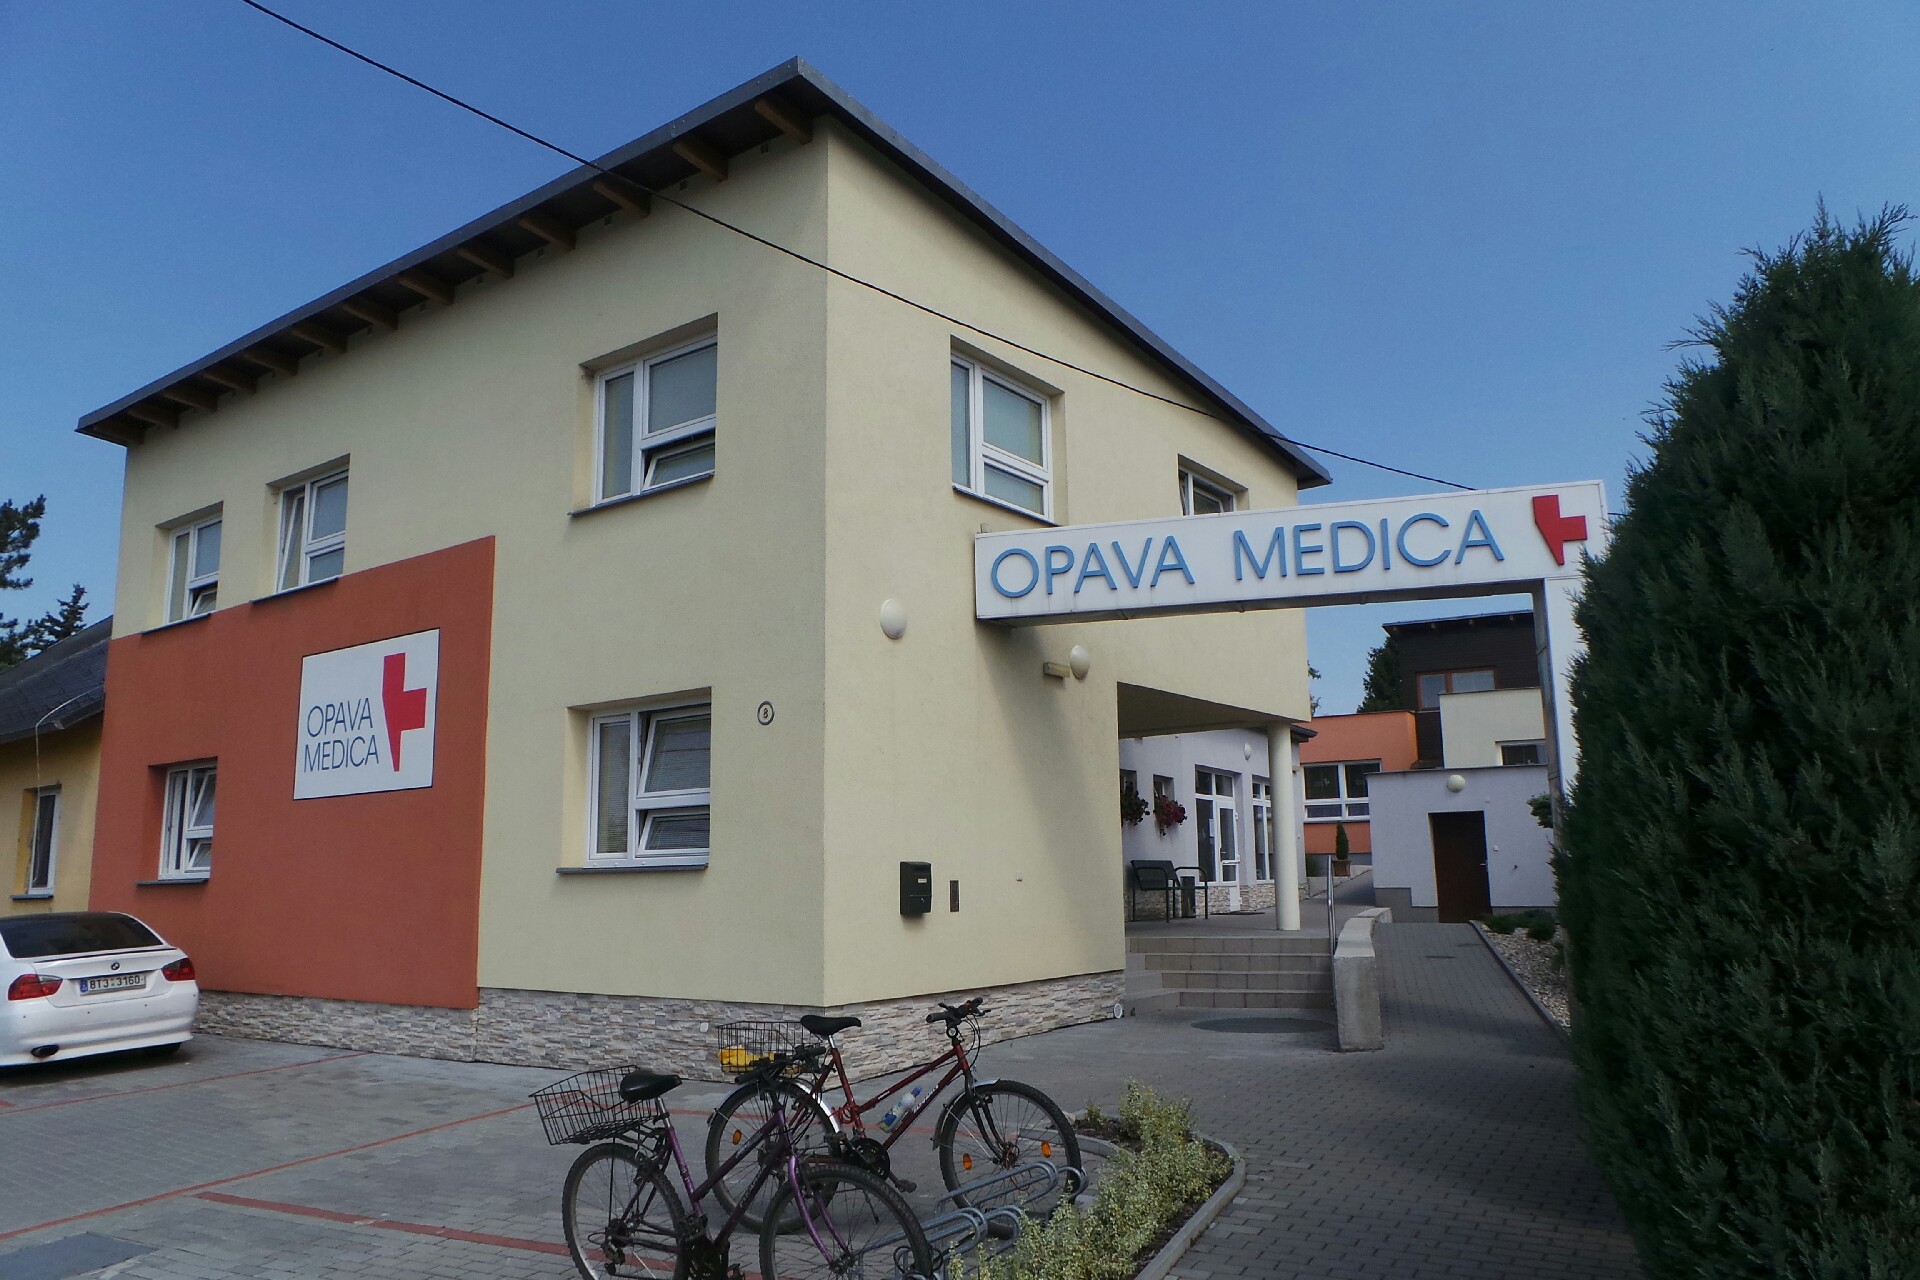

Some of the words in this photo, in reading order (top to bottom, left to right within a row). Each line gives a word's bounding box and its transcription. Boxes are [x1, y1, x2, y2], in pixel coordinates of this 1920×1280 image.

[990, 535, 1195, 599] OPAVA
[1233, 509, 1505, 581] MEDICA
[307, 698, 373, 737] OPAVA
[304, 735, 379, 773] MEDICA
[90, 979, 109, 989] 8T3
[116, 975, 140, 986] 3160
